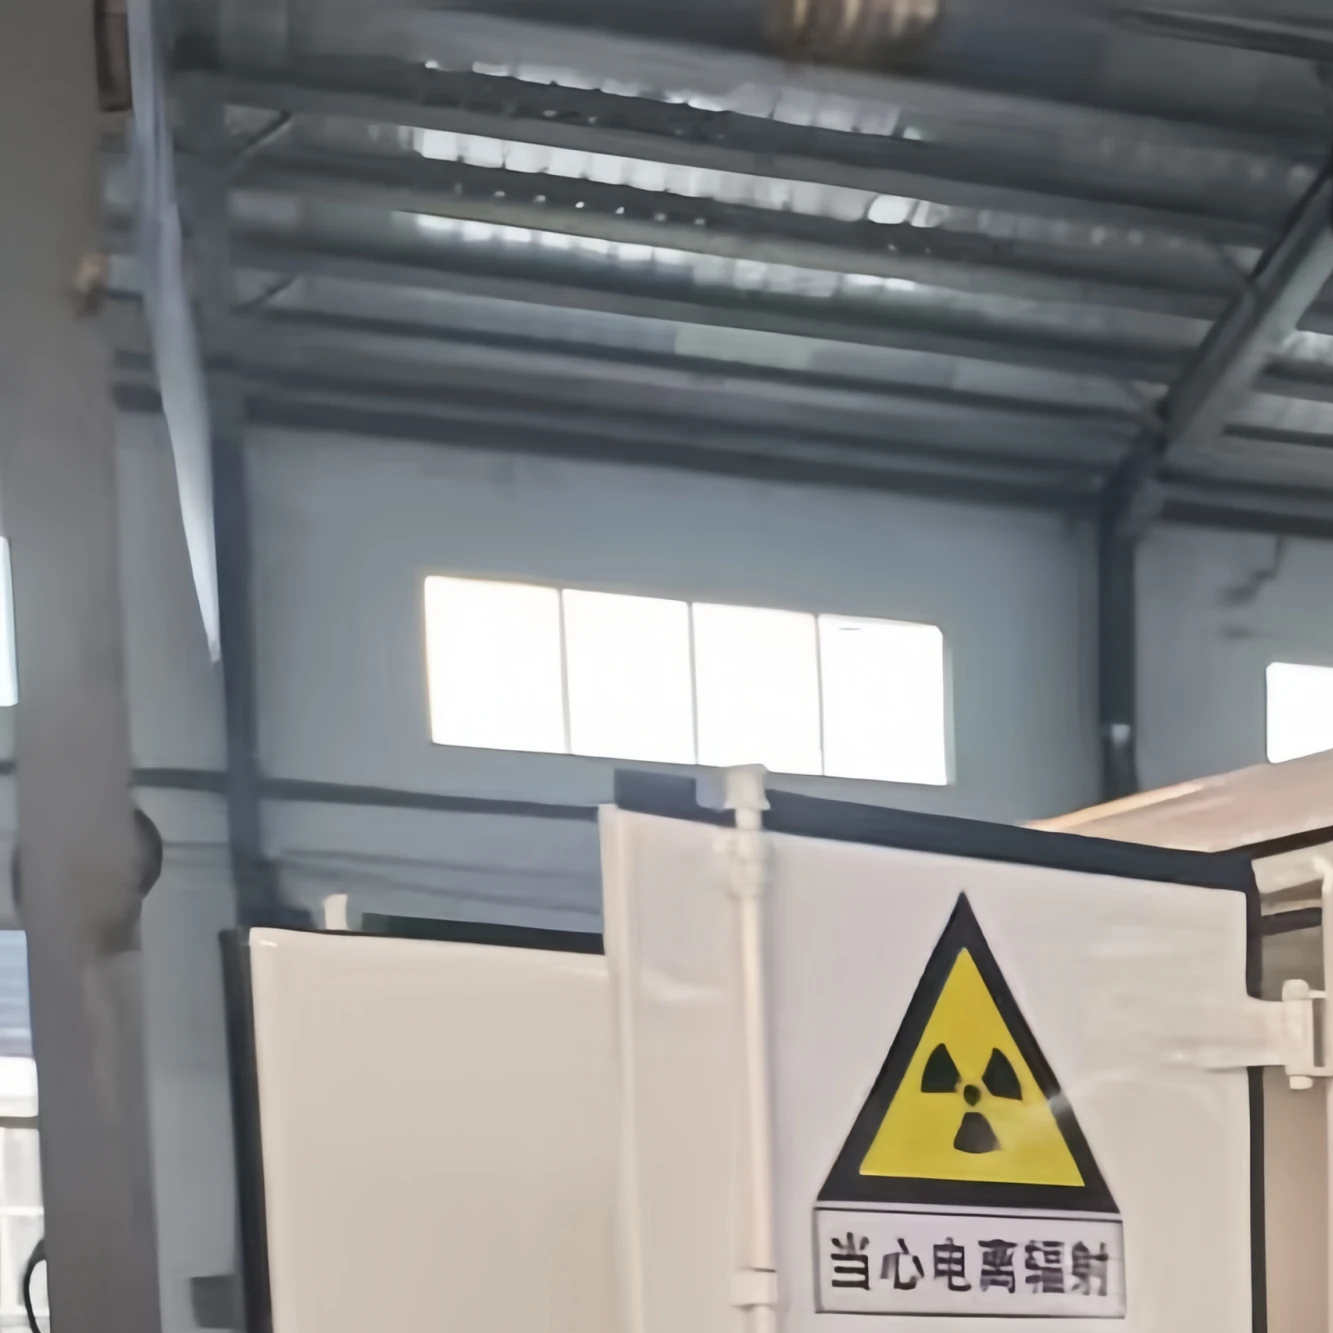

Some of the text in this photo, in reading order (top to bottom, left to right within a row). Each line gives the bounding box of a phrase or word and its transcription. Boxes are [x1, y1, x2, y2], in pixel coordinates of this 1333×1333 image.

[830, 1231, 1110, 1297] 当心电离辐射
